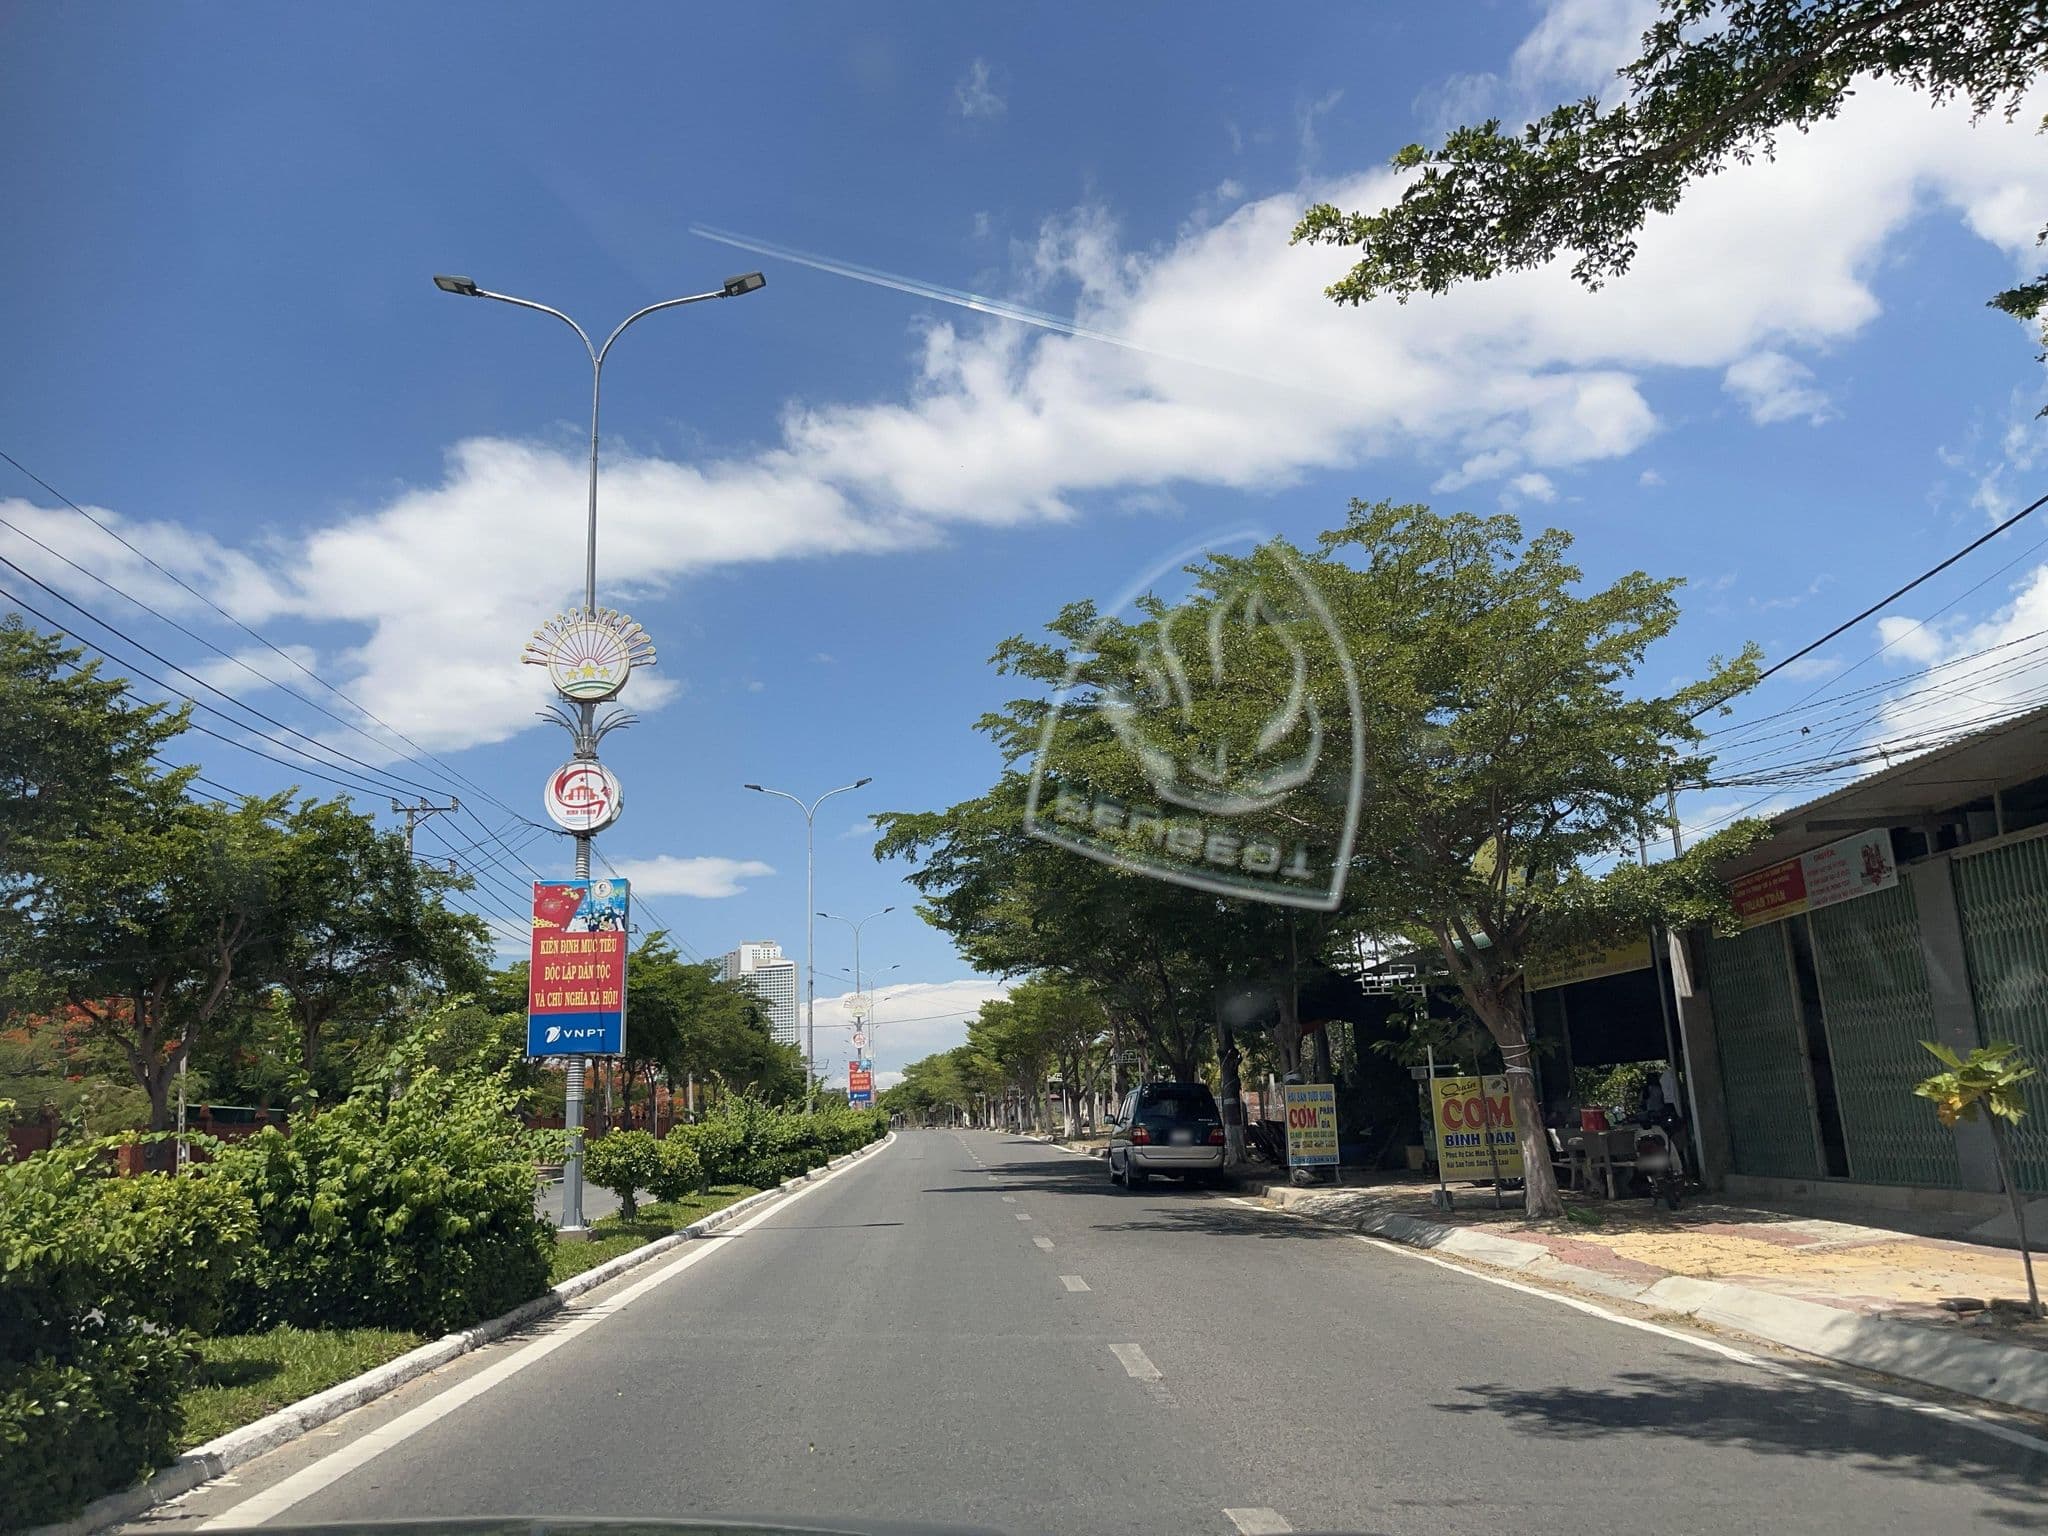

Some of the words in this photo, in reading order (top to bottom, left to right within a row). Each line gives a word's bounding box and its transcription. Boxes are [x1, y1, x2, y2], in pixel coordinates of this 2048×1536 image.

[540, 936, 559, 954] KIÊN
[560, 939, 580, 956] ĐỊNH
[581, 938, 598, 956] MỤC
[599, 934, 617, 953] TIÊU
[544, 962, 560, 983] ĐỘC
[562, 962, 577, 983] LẬP
[578, 961, 594, 979] DÂN
[595, 960, 611, 982] TỘC
[535, 989, 545, 1007] VÀ
[547, 986, 563, 1007] CHỦ
[564, 987, 588, 1006] NGHĨA
[589, 988, 601, 1005] XÃ
[563, 1028, 606, 1038] VNPT
[1445, 1132, 1480, 1148] BÌNH
